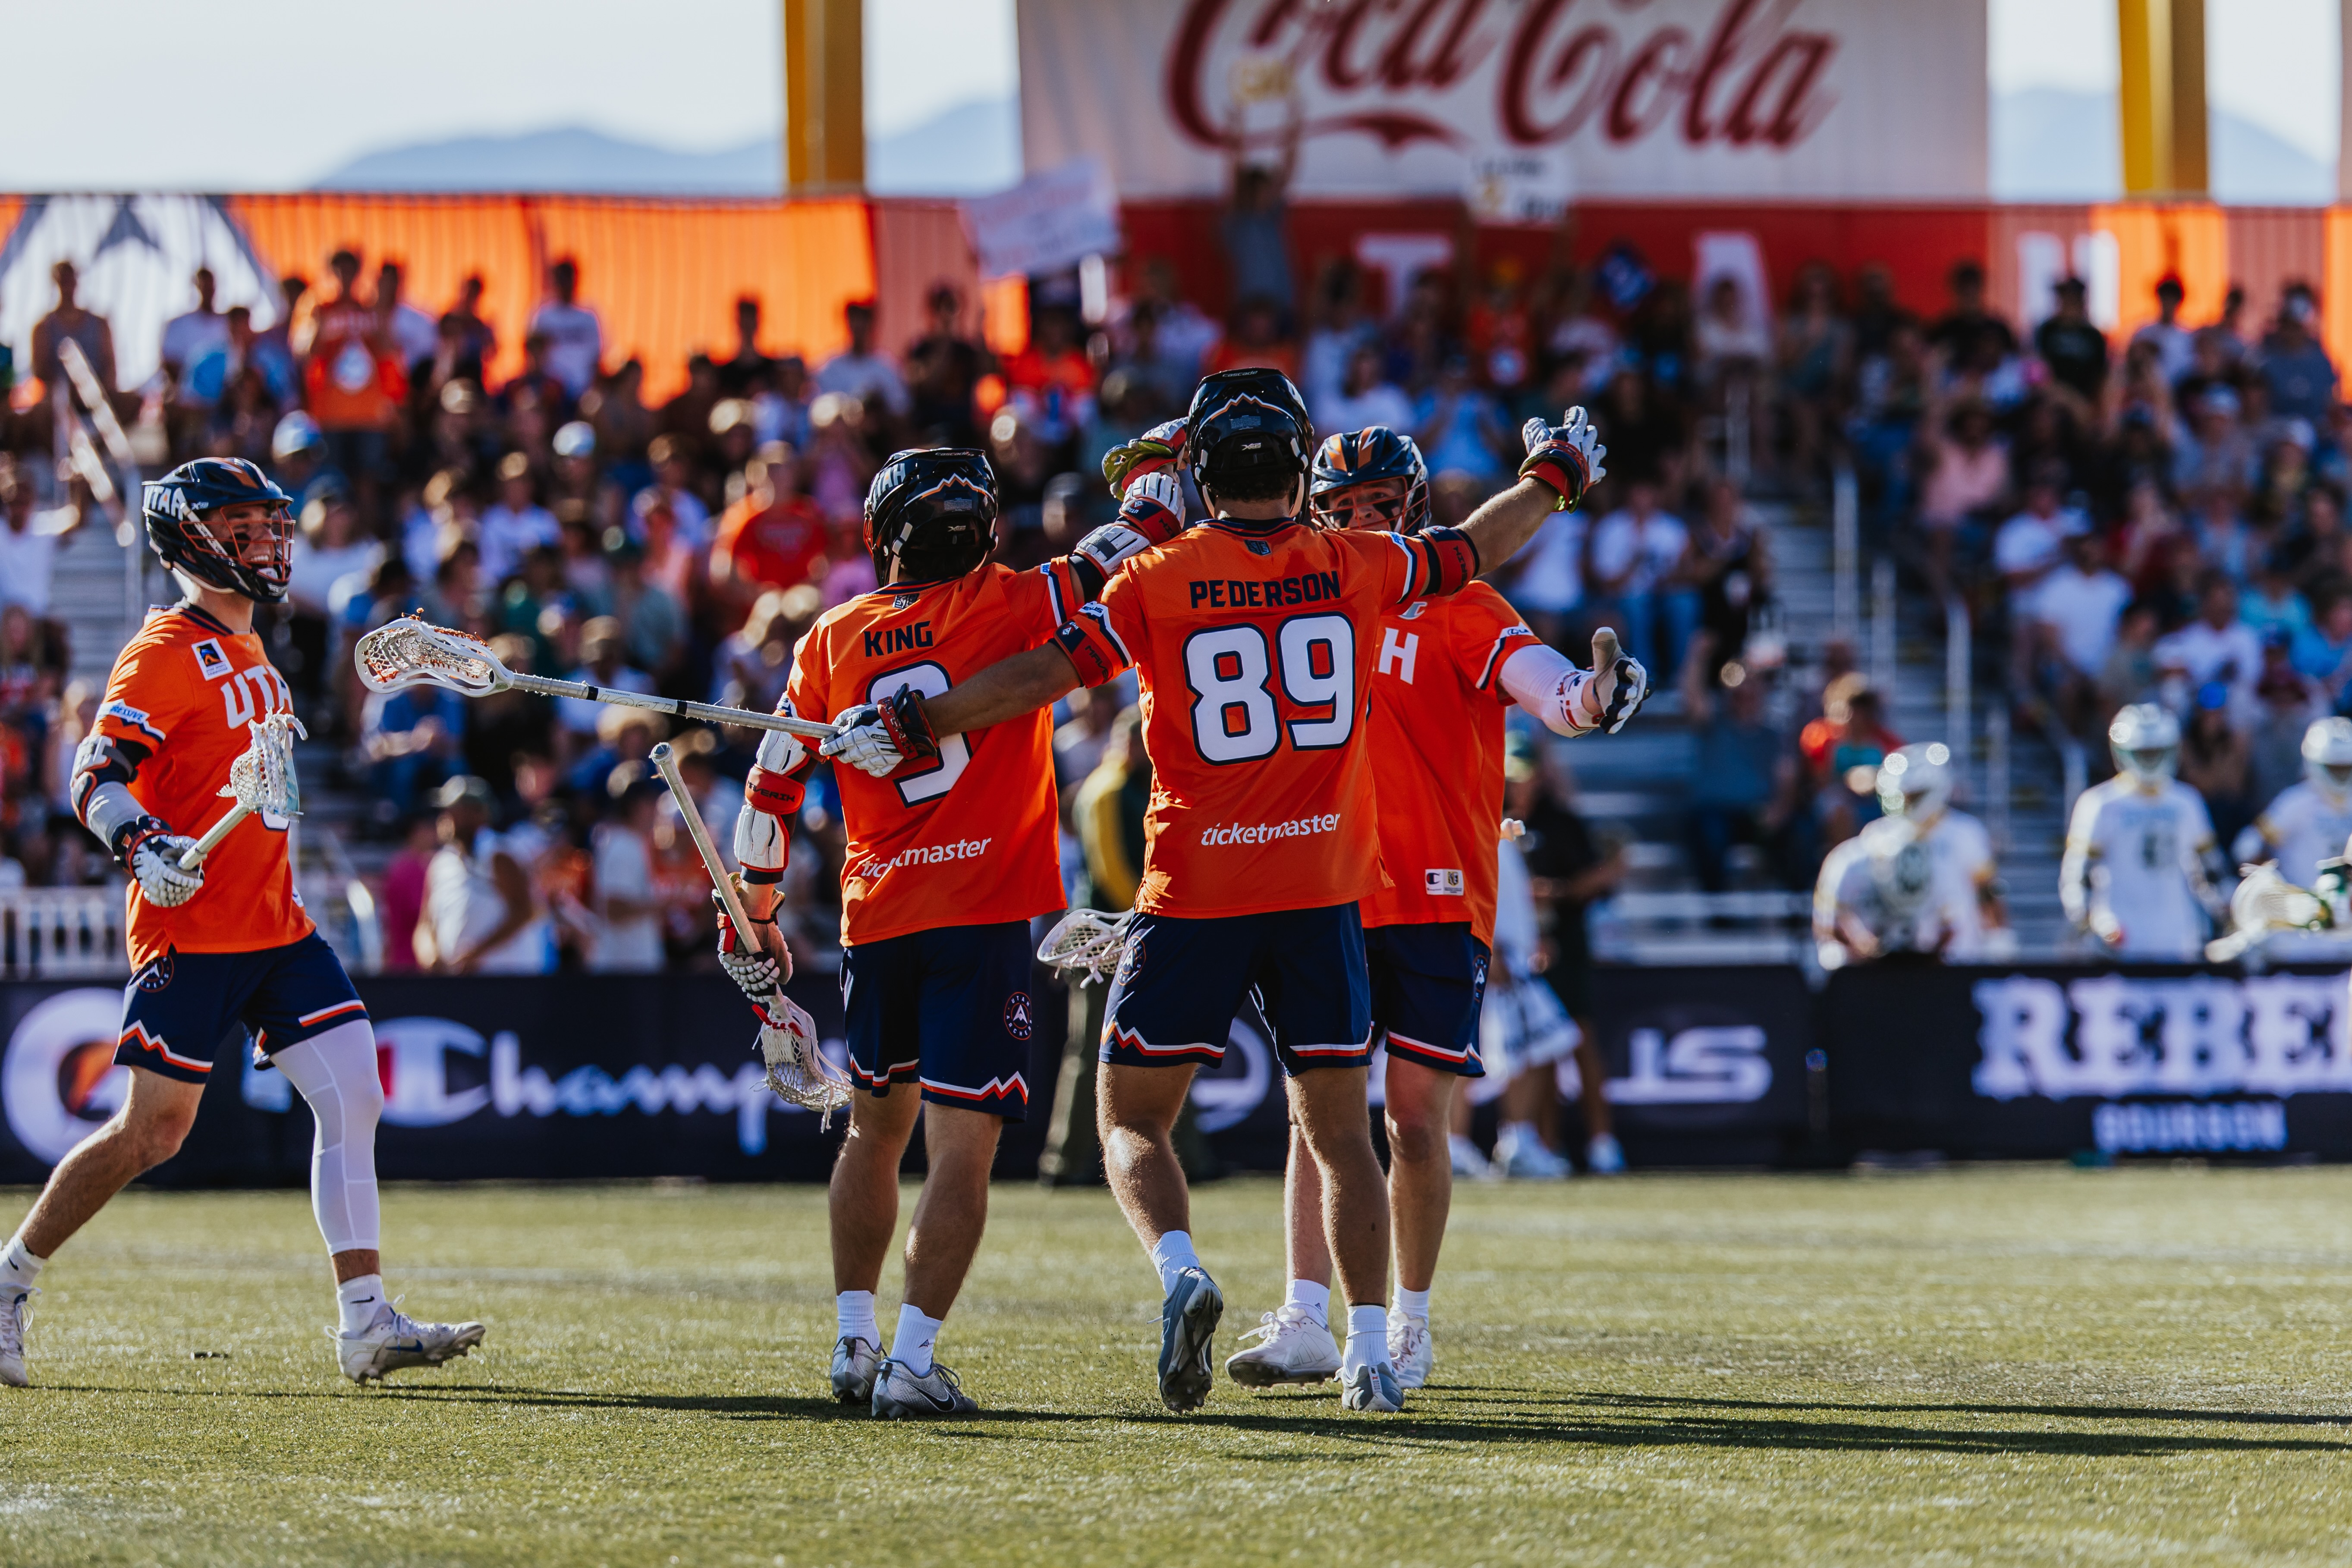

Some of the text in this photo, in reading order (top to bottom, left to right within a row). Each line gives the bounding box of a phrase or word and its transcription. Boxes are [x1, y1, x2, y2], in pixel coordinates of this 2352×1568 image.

[1164, 0, 1841, 149] CocaCola
[1189, 571, 1341, 609] PEDERSON
[864, 620, 933, 657] KING
[220, 665, 294, 730] UTA
[1182, 610, 1356, 767] 89
[1201, 813, 1340, 845] ticketmaster
[1011, 996, 1030, 1006] UTAH
[1006, 1015, 1032, 1036] ARCHERS
[372, 1016, 849, 1155] Champ
